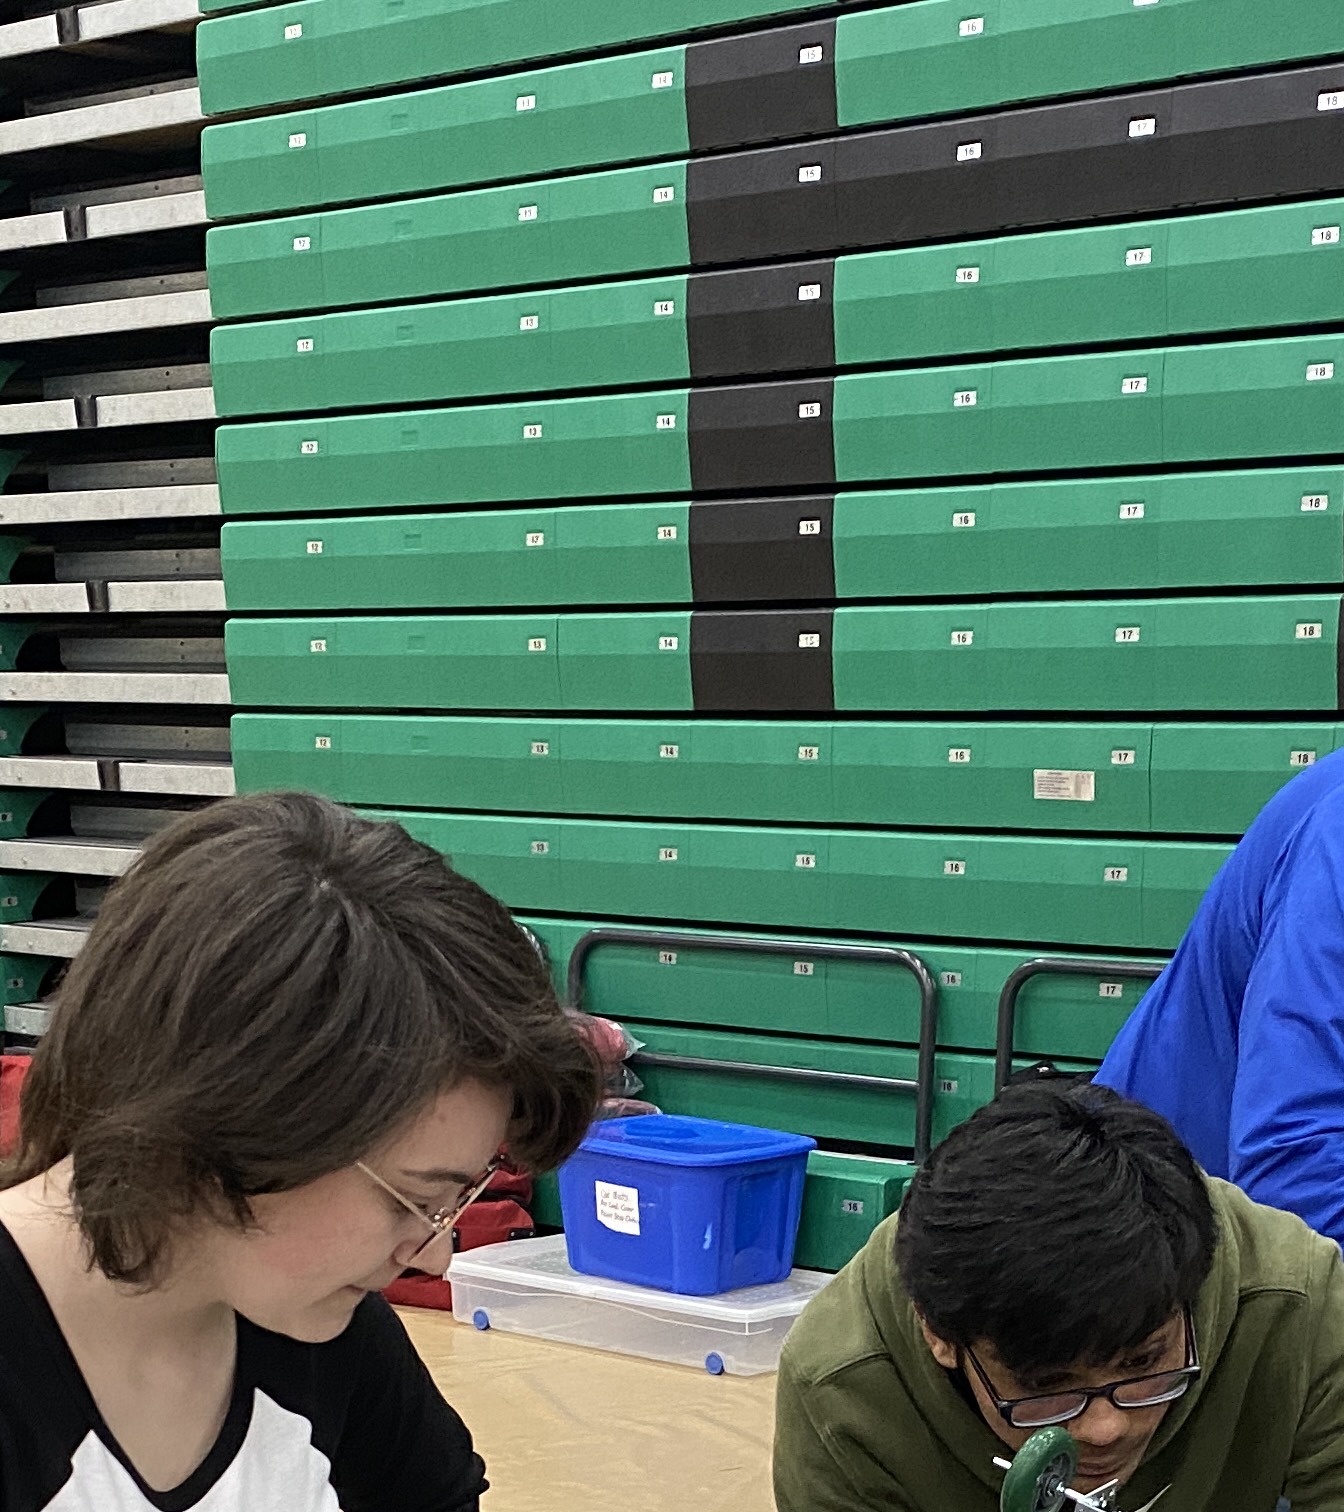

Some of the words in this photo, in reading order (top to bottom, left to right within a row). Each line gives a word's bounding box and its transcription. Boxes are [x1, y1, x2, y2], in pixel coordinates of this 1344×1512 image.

[1327, 95, 1338, 106] 18
[1320, 230, 1332, 241] 18
[1315, 367, 1326, 376] 18
[1309, 498, 1320, 508] 18
[1303, 626, 1314, 636] 18
[1298, 753, 1309, 764] 18
